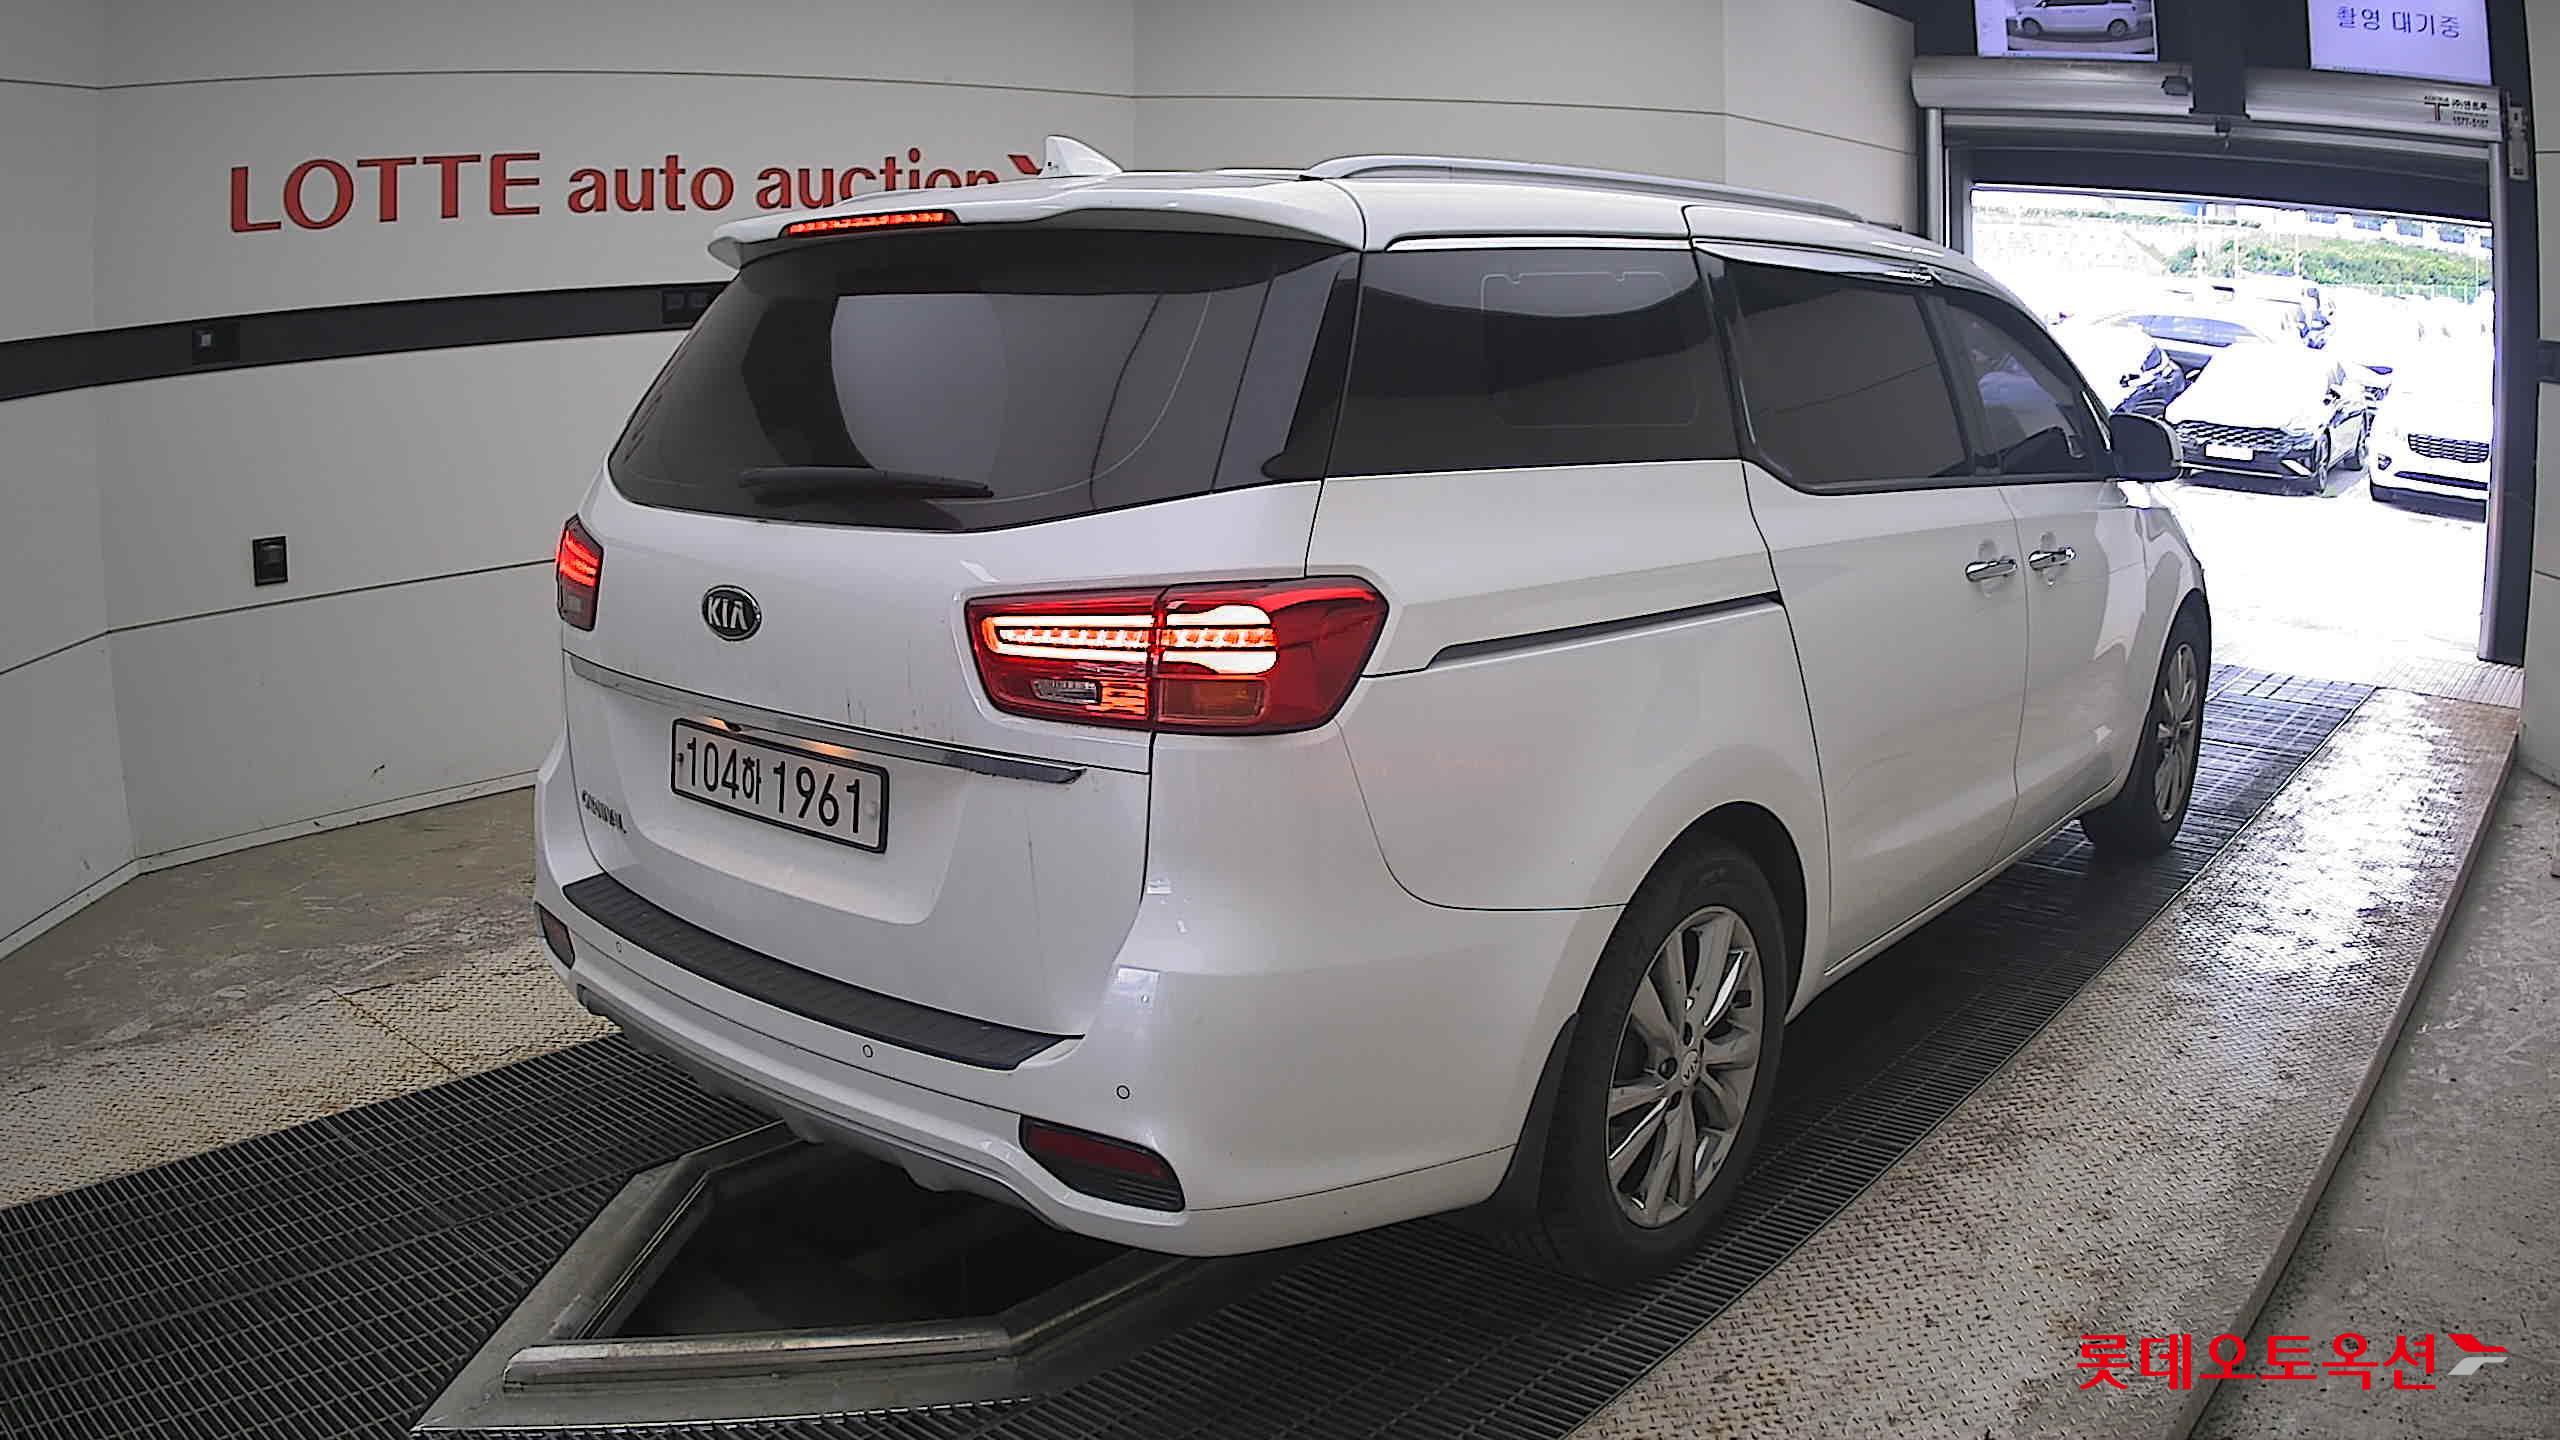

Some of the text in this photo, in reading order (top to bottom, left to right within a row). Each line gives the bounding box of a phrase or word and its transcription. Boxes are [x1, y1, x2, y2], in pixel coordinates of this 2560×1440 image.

[2337, 6, 2460, 39] 촬영 대기중
[230, 150, 542, 233] LOTTE
[567, 155, 735, 213] auto
[708, 596, 748, 630] KIA
